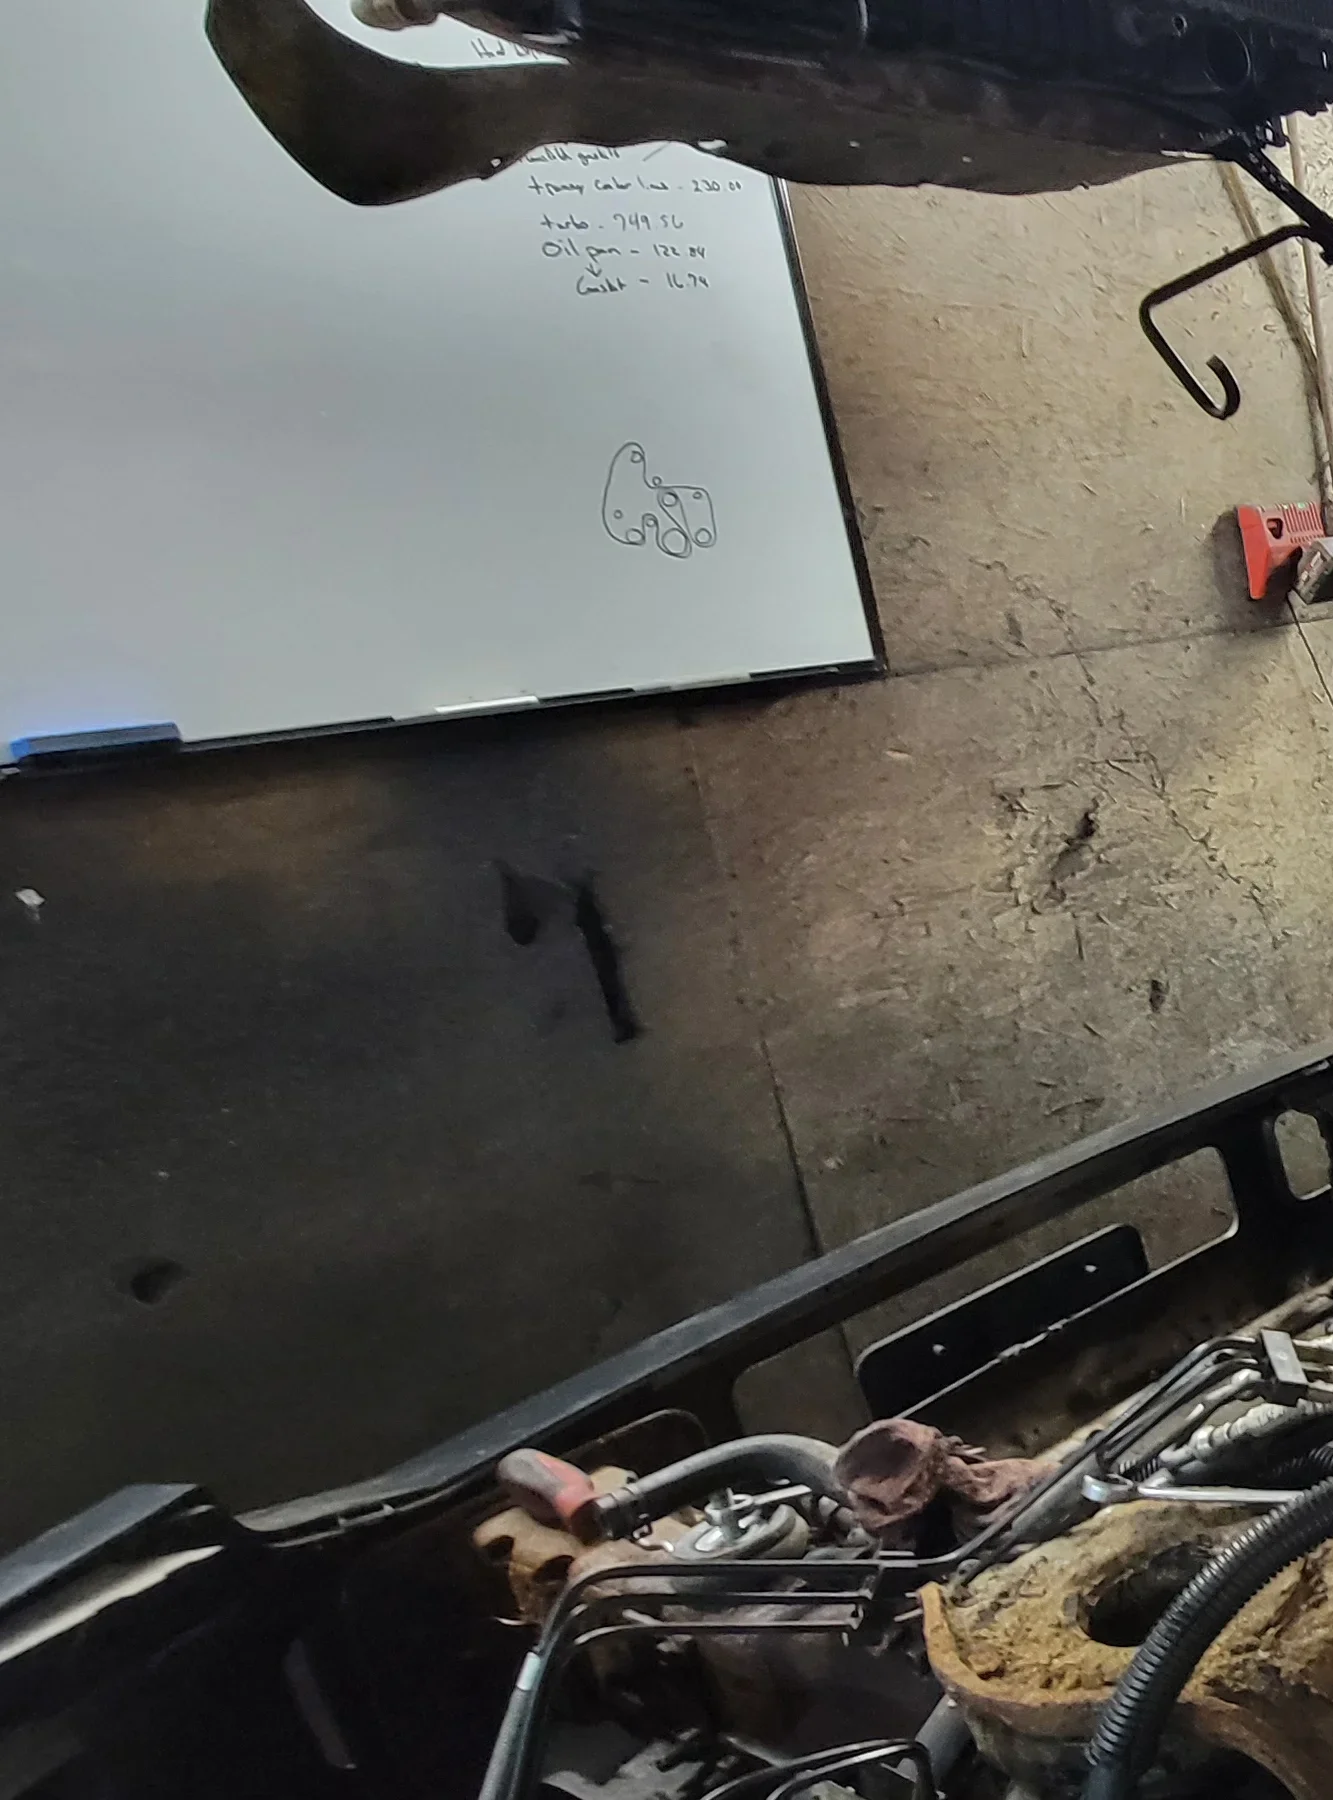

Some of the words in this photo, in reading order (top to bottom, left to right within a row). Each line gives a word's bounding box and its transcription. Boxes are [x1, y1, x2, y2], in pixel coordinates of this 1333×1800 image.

[540, 213, 589, 230] turbo
[612, 211, 684, 232] 749.56
[541, 237, 580, 258] Oil
[584, 245, 622, 263] pan
